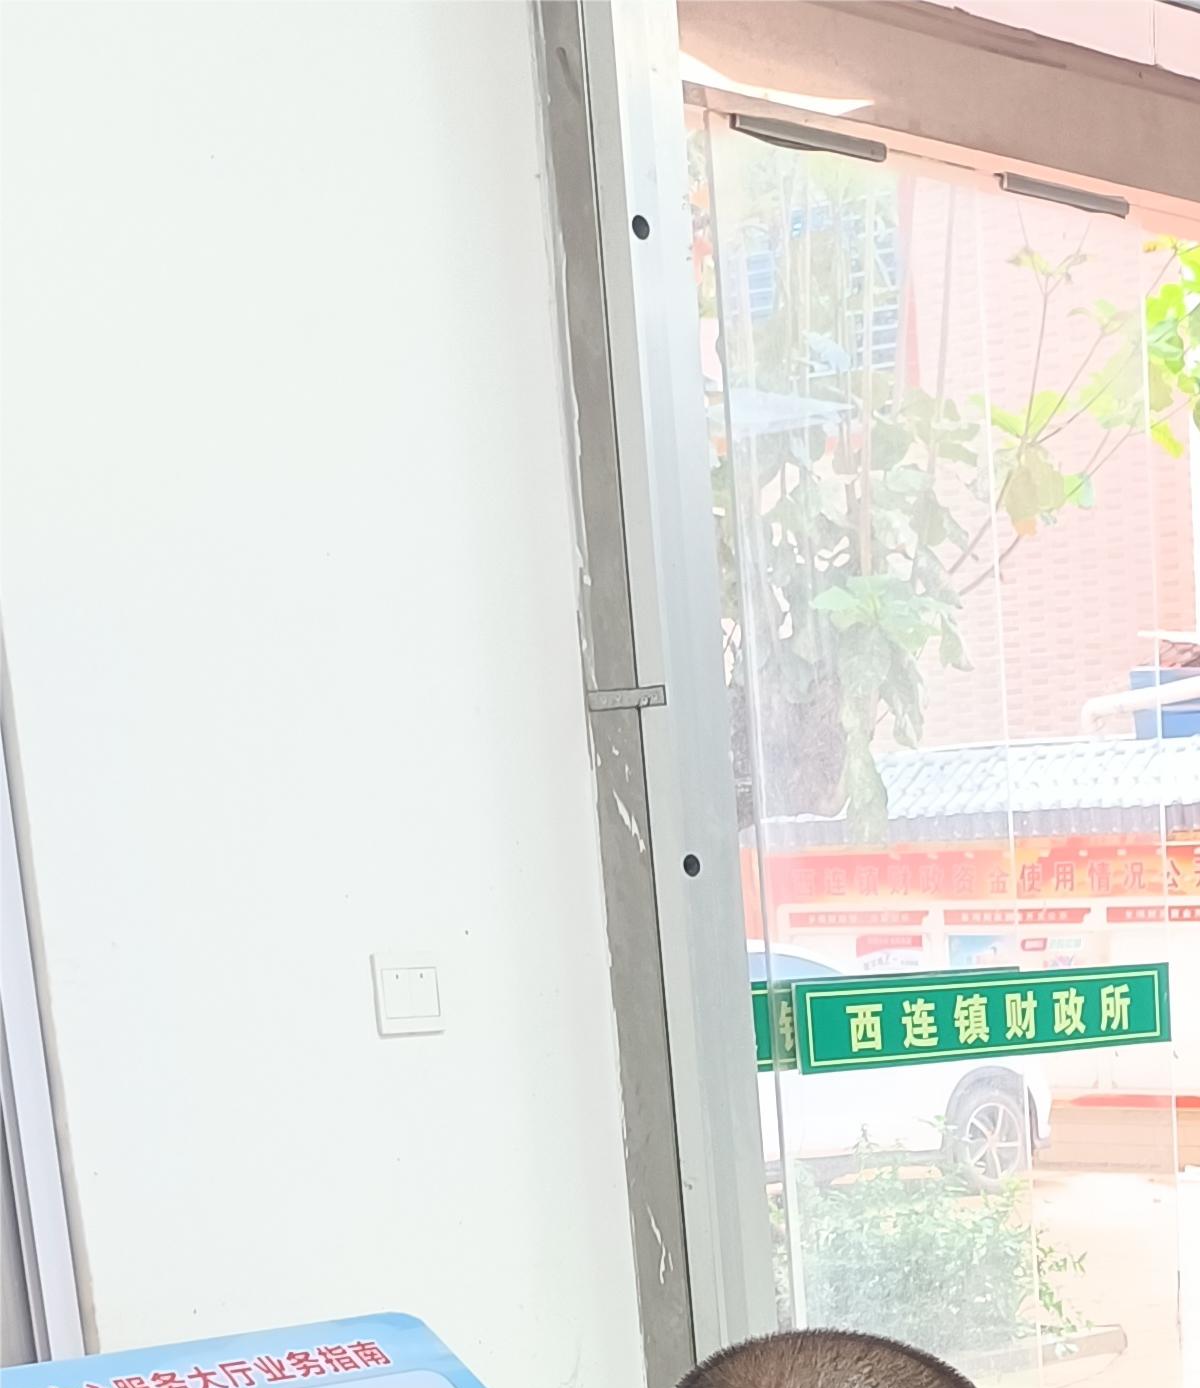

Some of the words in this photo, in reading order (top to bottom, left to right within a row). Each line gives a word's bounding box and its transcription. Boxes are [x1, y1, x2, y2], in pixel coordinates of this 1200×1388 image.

[845, 983, 1132, 1053] 西连镇财政所
